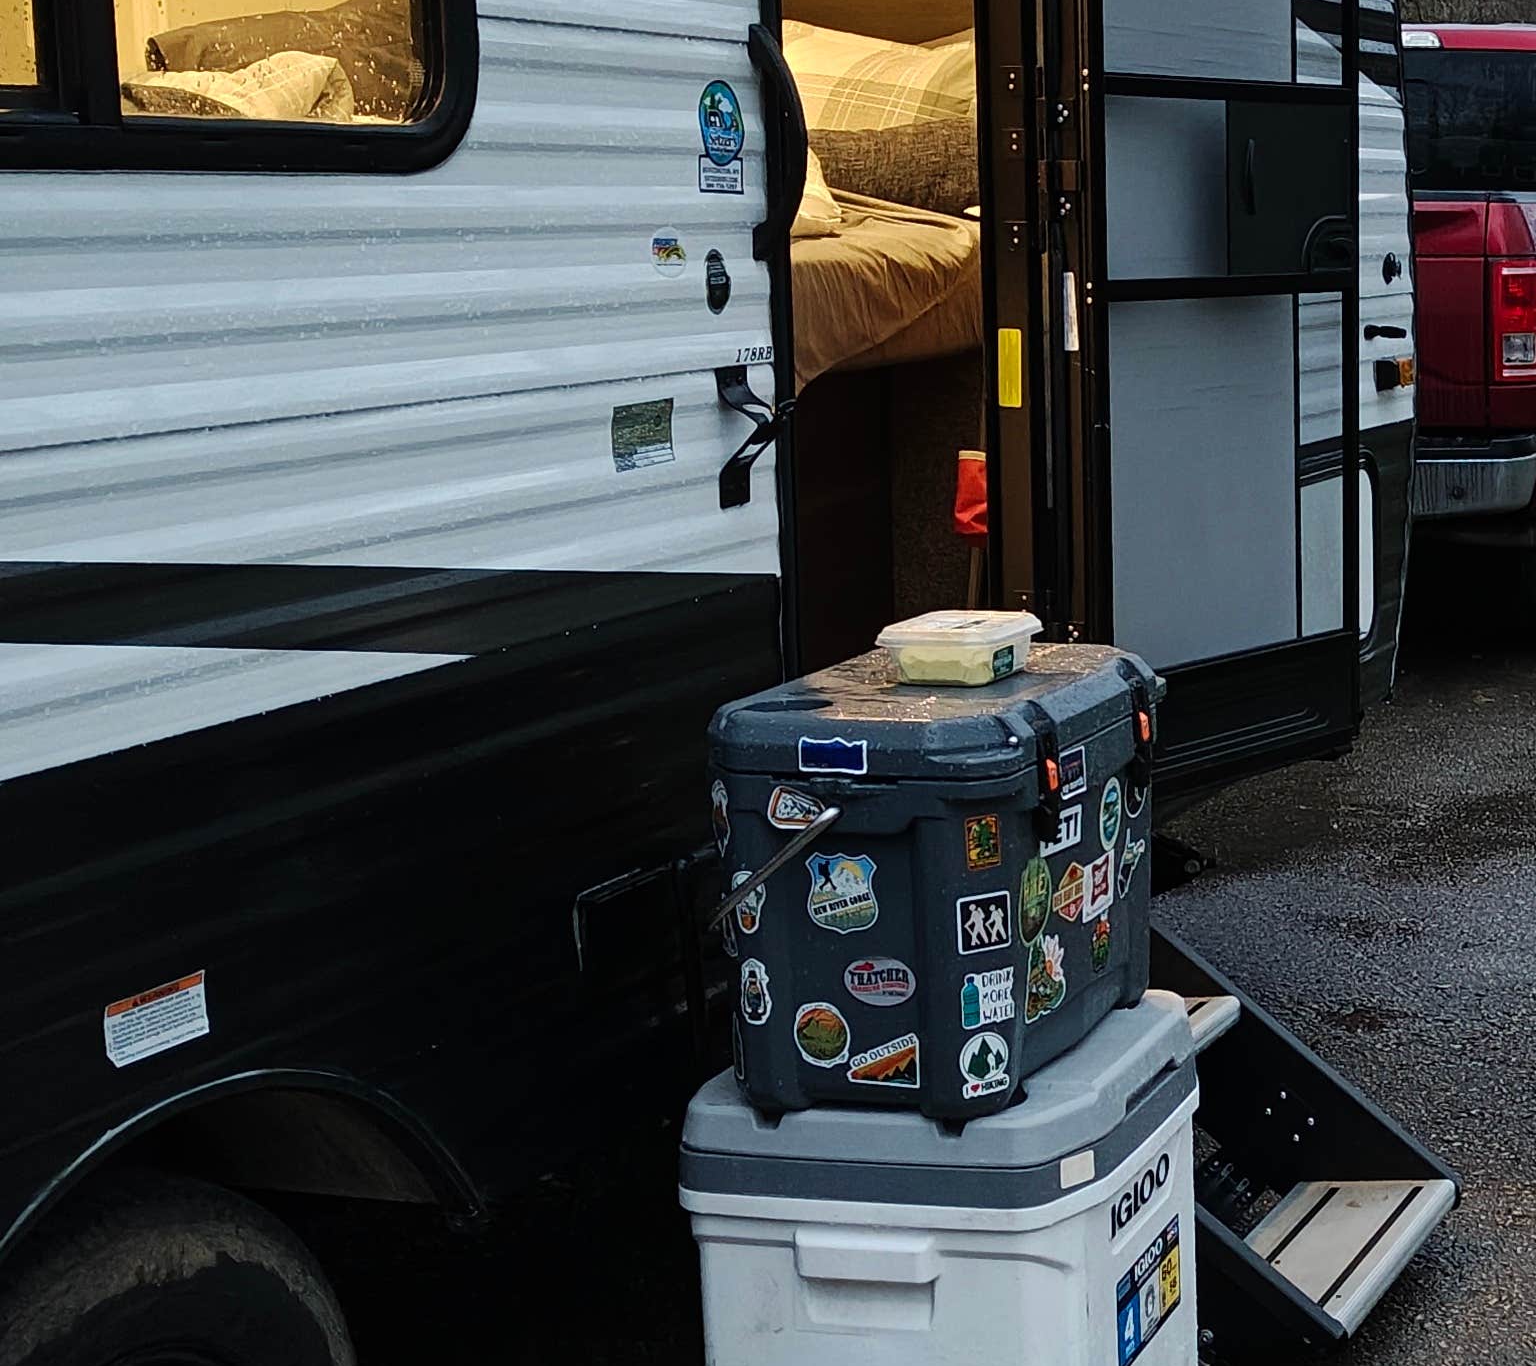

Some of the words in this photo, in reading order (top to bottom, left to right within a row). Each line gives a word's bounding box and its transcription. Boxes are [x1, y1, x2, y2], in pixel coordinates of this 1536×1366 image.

[735, 345, 773, 363] 178RB
[813, 904, 828, 916] NEW
[828, 898, 849, 912] RIVER
[849, 891, 872, 906] GORGE
[847, 967, 910, 986] THATCHER
[981, 970, 1012, 988] DRINK
[981, 987, 1010, 1004] MORE
[852, 1055, 868, 1068] GO
[868, 1035, 916, 1061] OUTSIDE
[980, 1077, 1008, 1092] HIKING
[1110, 1152, 1170, 1240] IGLOO
[1134, 1236, 1164, 1282] IGLOO
[1124, 1306, 1135, 1342] 4
